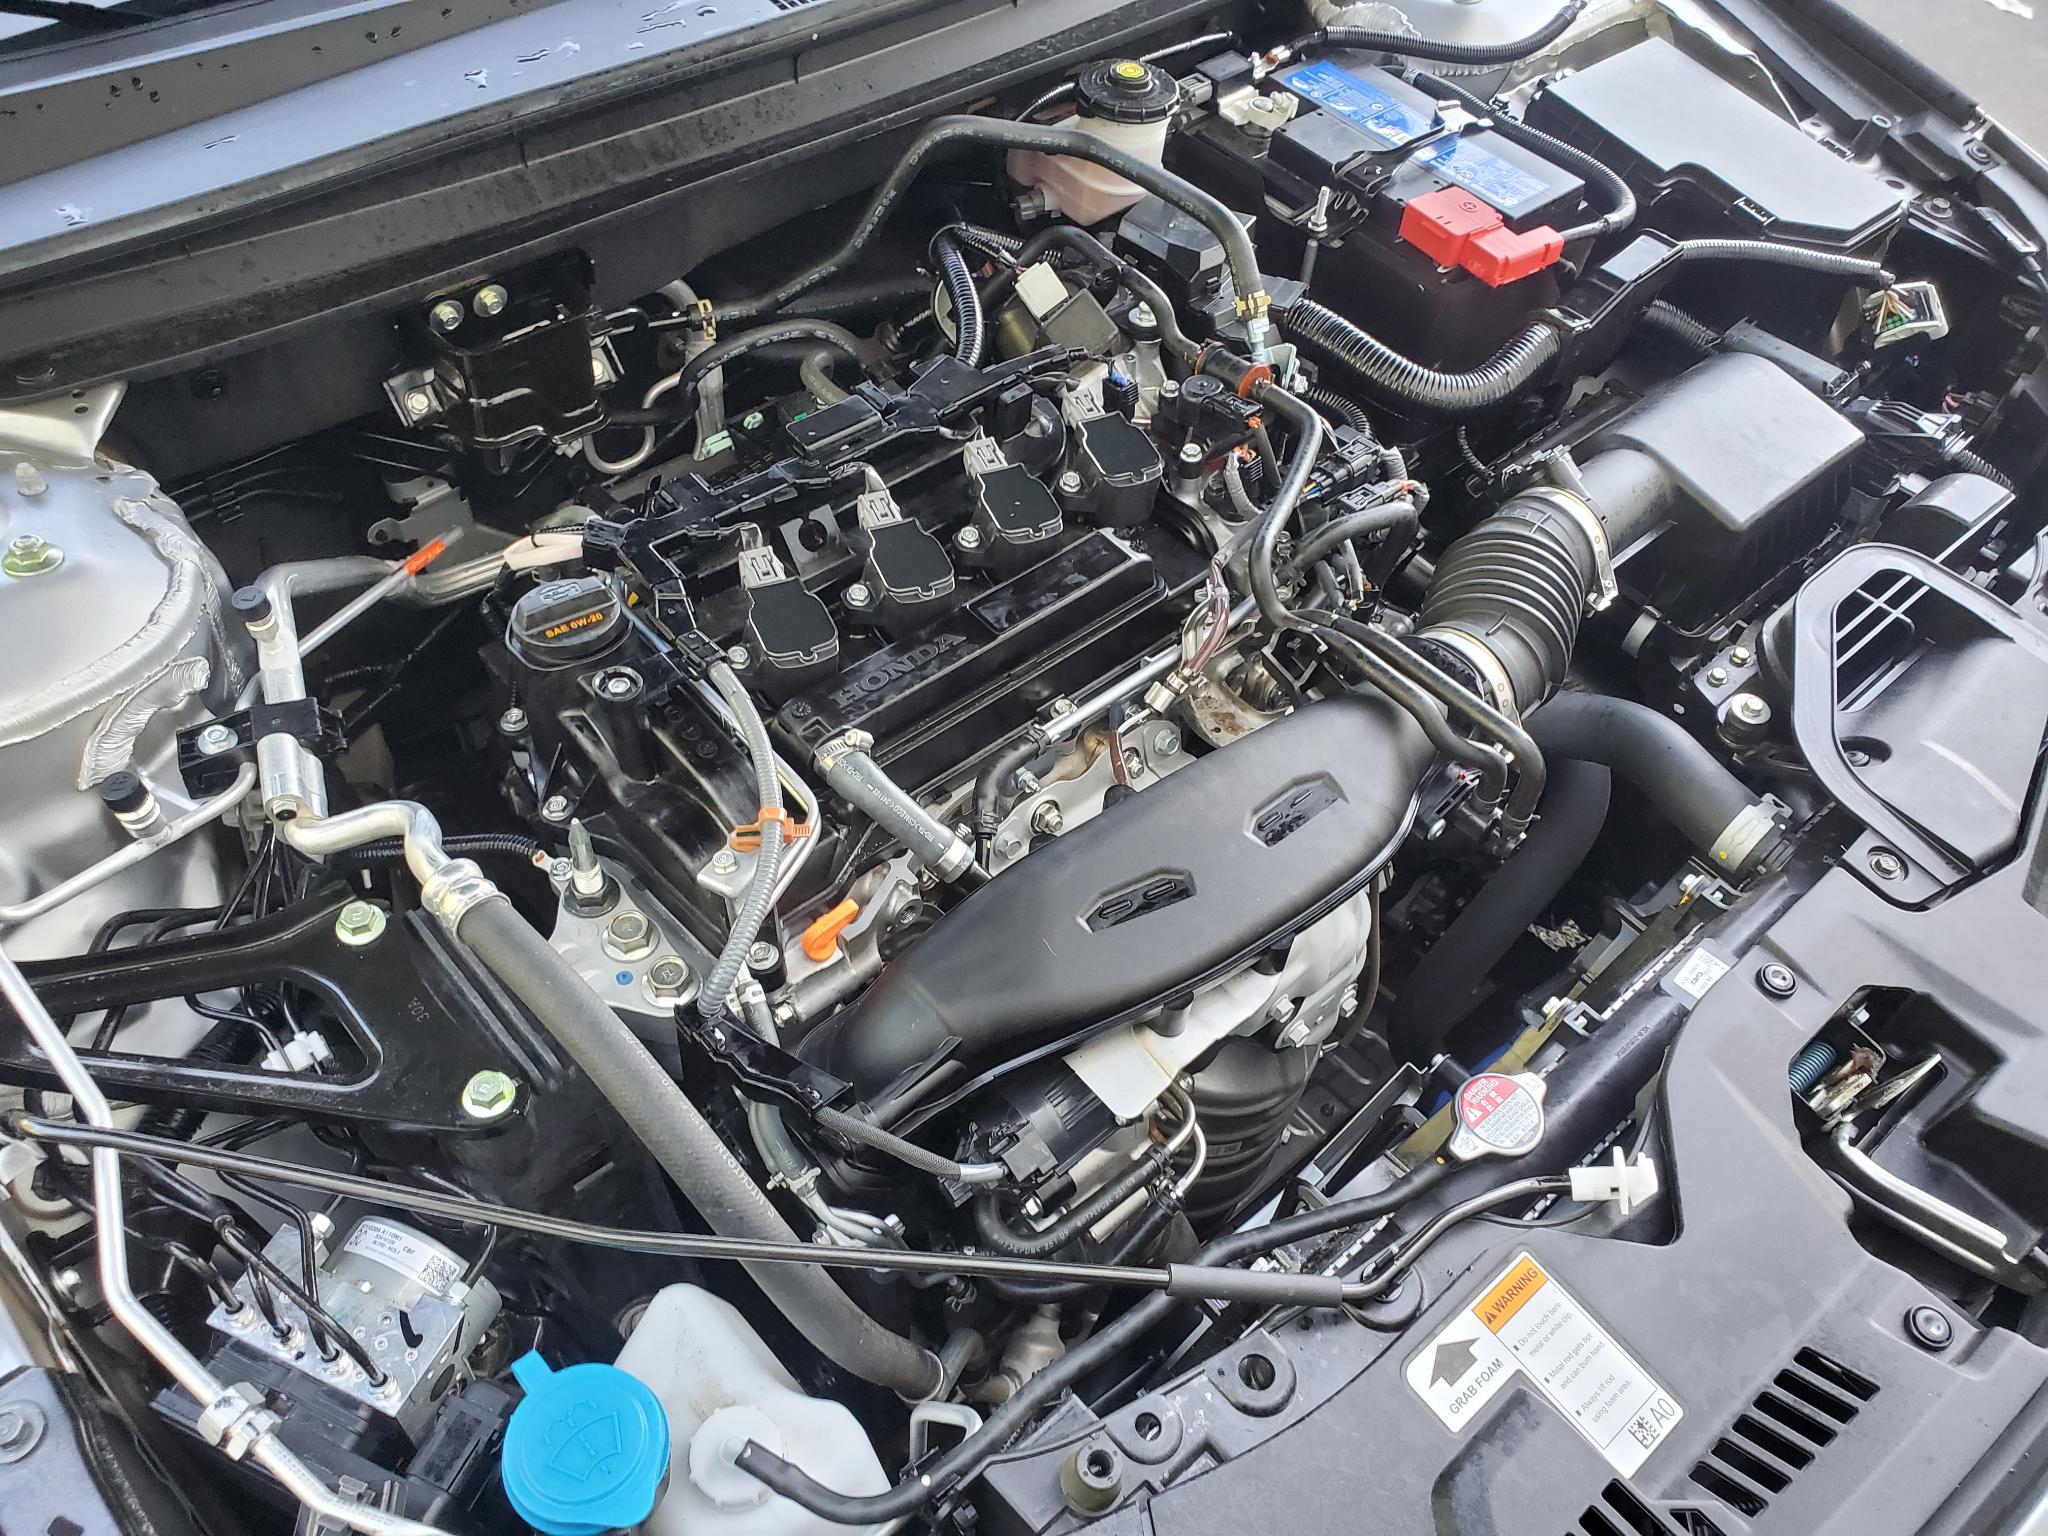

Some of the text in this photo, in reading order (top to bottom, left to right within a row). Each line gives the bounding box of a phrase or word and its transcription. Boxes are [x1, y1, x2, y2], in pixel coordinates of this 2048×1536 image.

[545, 612, 604, 639] SAE 0W-20
[830, 633, 967, 707] HONDA
[1463, 1078, 1487, 1100] DANGER
[1491, 1266, 1538, 1313] WARNING
[1449, 1358, 1504, 1414] GRAB FOAM
